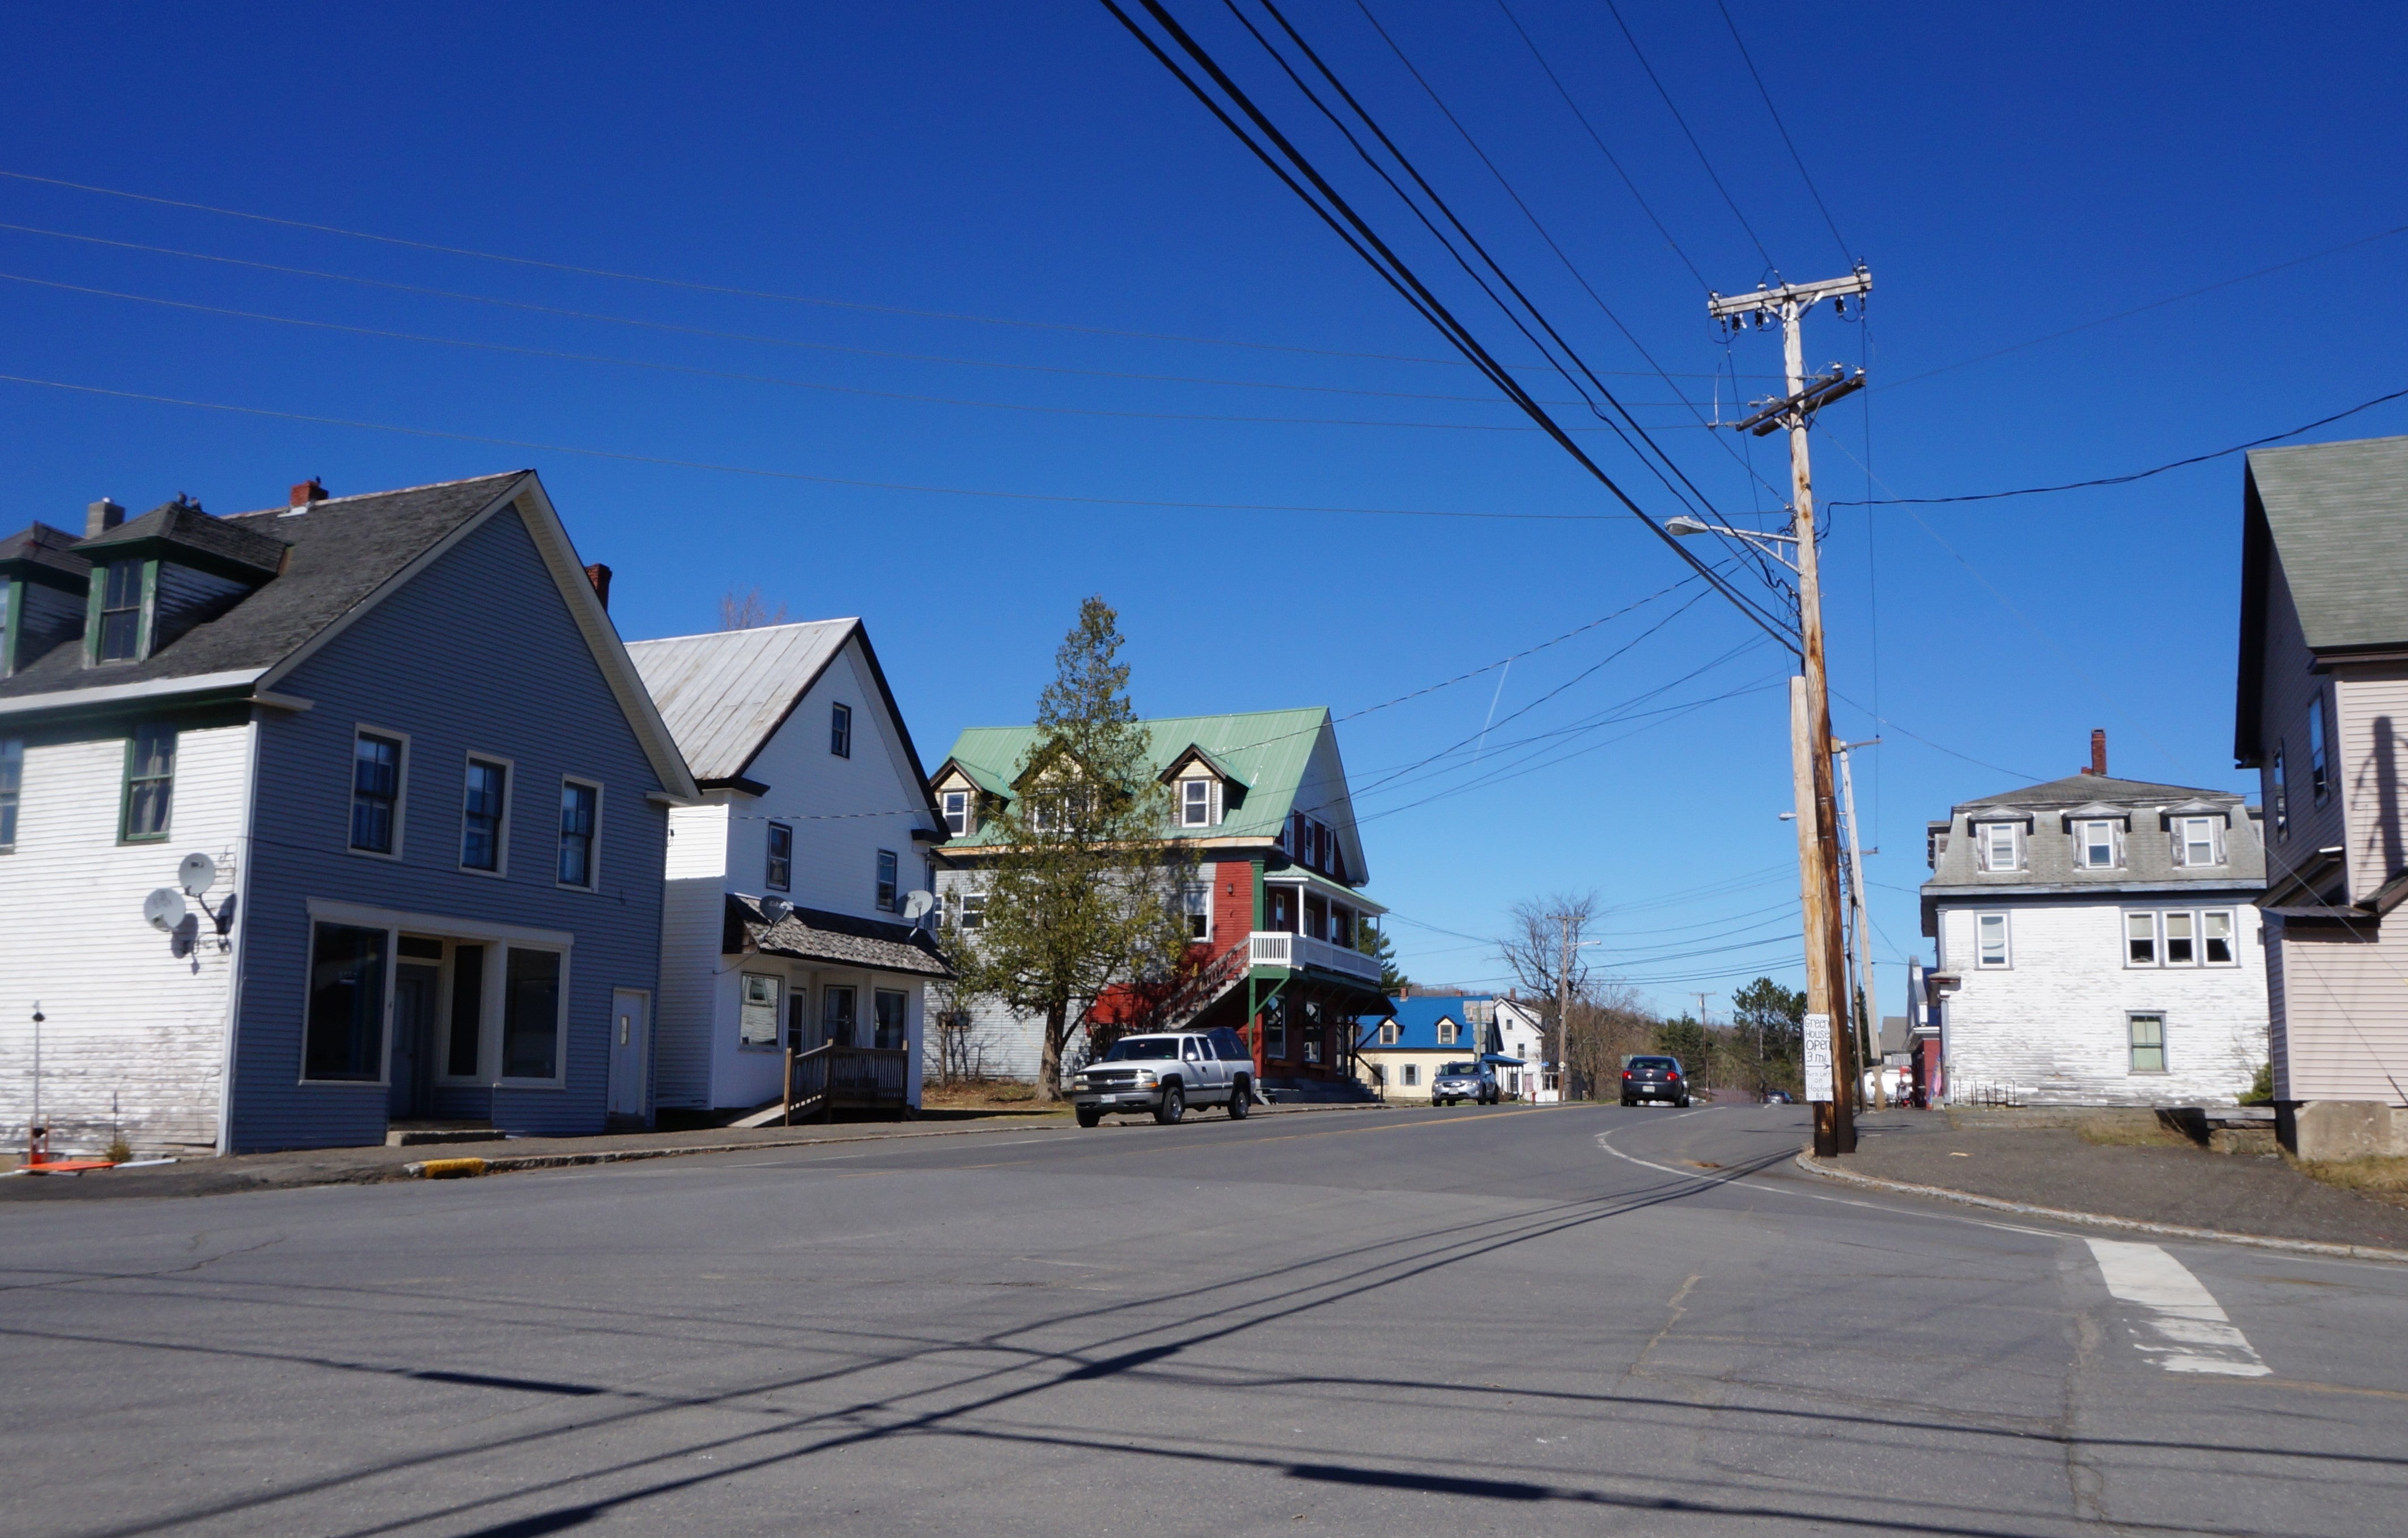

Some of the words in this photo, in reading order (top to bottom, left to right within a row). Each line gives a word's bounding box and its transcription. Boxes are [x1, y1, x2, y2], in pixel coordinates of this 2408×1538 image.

[1805, 1018, 1830, 1029] Green
[1806, 1029, 1830, 1039] House
[1807, 1051, 1813, 1062] 3
